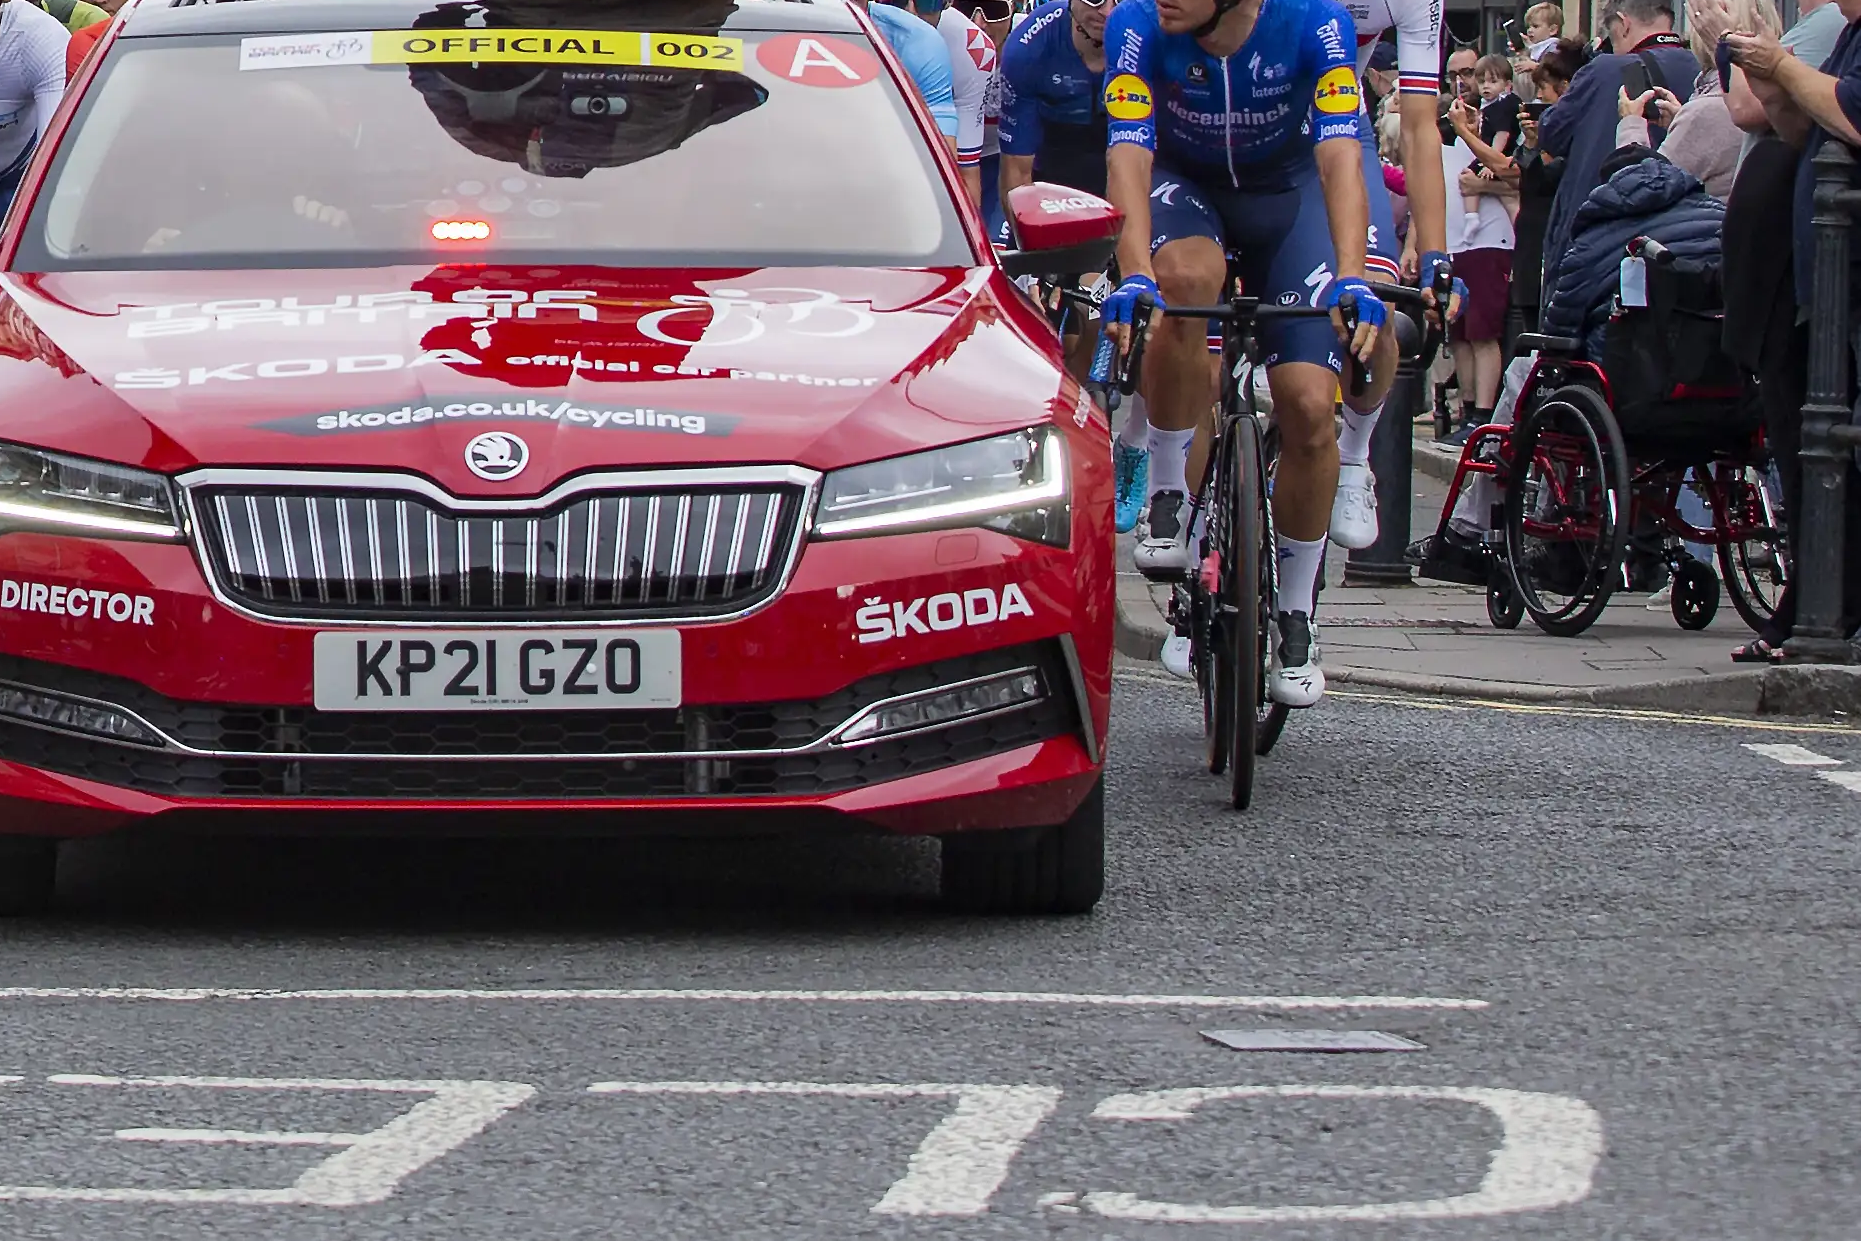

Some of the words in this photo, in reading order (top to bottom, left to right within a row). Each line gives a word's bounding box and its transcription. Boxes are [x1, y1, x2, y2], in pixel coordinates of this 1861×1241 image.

[1019, 7, 1064, 46] wahoo
[402, 37, 616, 57] OFFICIAL
[656, 40, 736, 61] 002
[788, 39, 862, 86] A
[1251, 82, 1292, 99] latexco
[114, 349, 483, 389] ŠKODA
[505, 351, 639, 374] official
[652, 362, 717, 377] car
[730, 367, 880, 388] partner
[316, 399, 707, 435] skoda.co.uk/cycling
[1, 579, 155, 626] DIRECTOR
[855, 581, 1035, 644] ŠKODA
[355, 639, 497, 697] KP21
[519, 637, 642, 695] GZO
